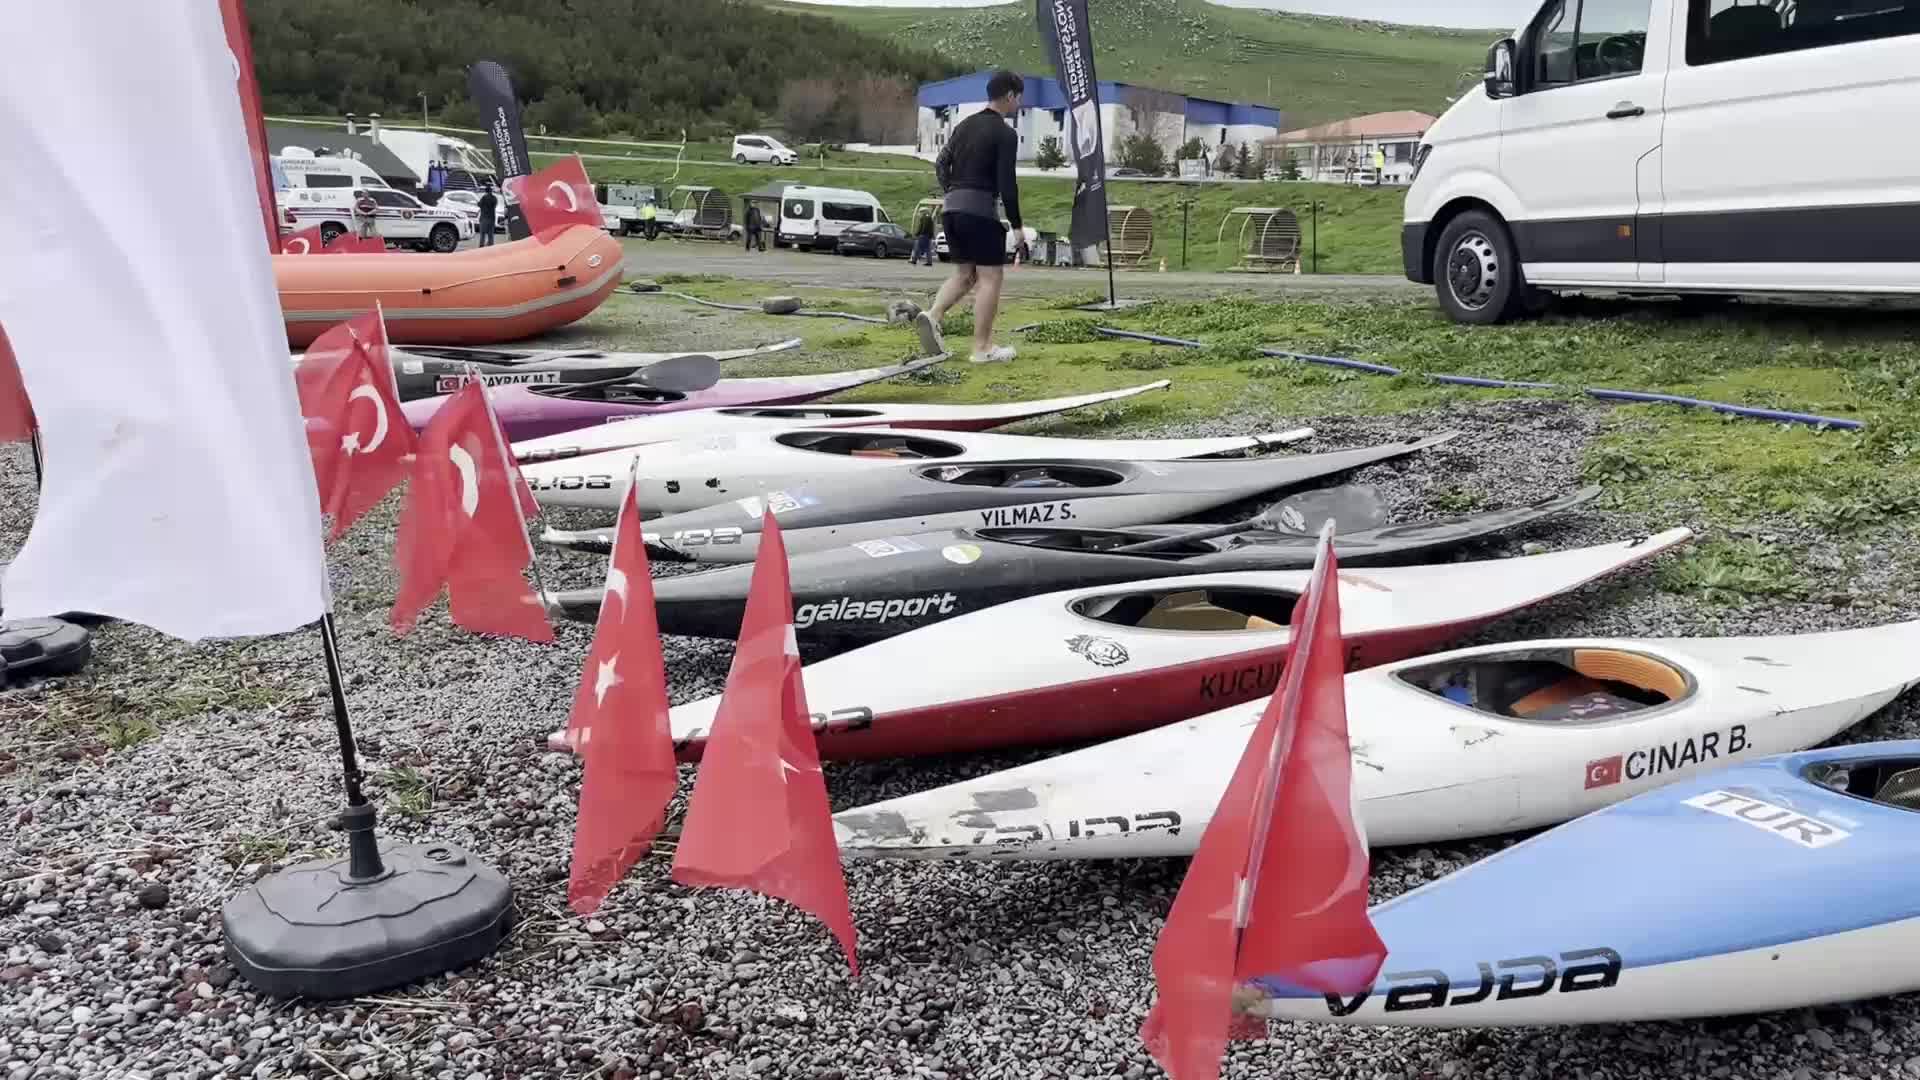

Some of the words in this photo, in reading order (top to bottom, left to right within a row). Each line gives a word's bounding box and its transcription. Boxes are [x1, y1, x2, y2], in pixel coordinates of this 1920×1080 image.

[981, 504, 1054, 526] YILMAZ
[1060, 502, 1077, 520] S.
[794, 592, 957, 629] galasport
[1624, 731, 1719, 780] CINAR
[1727, 724, 1752, 755] B.
[1703, 794, 1833, 844] TUR
